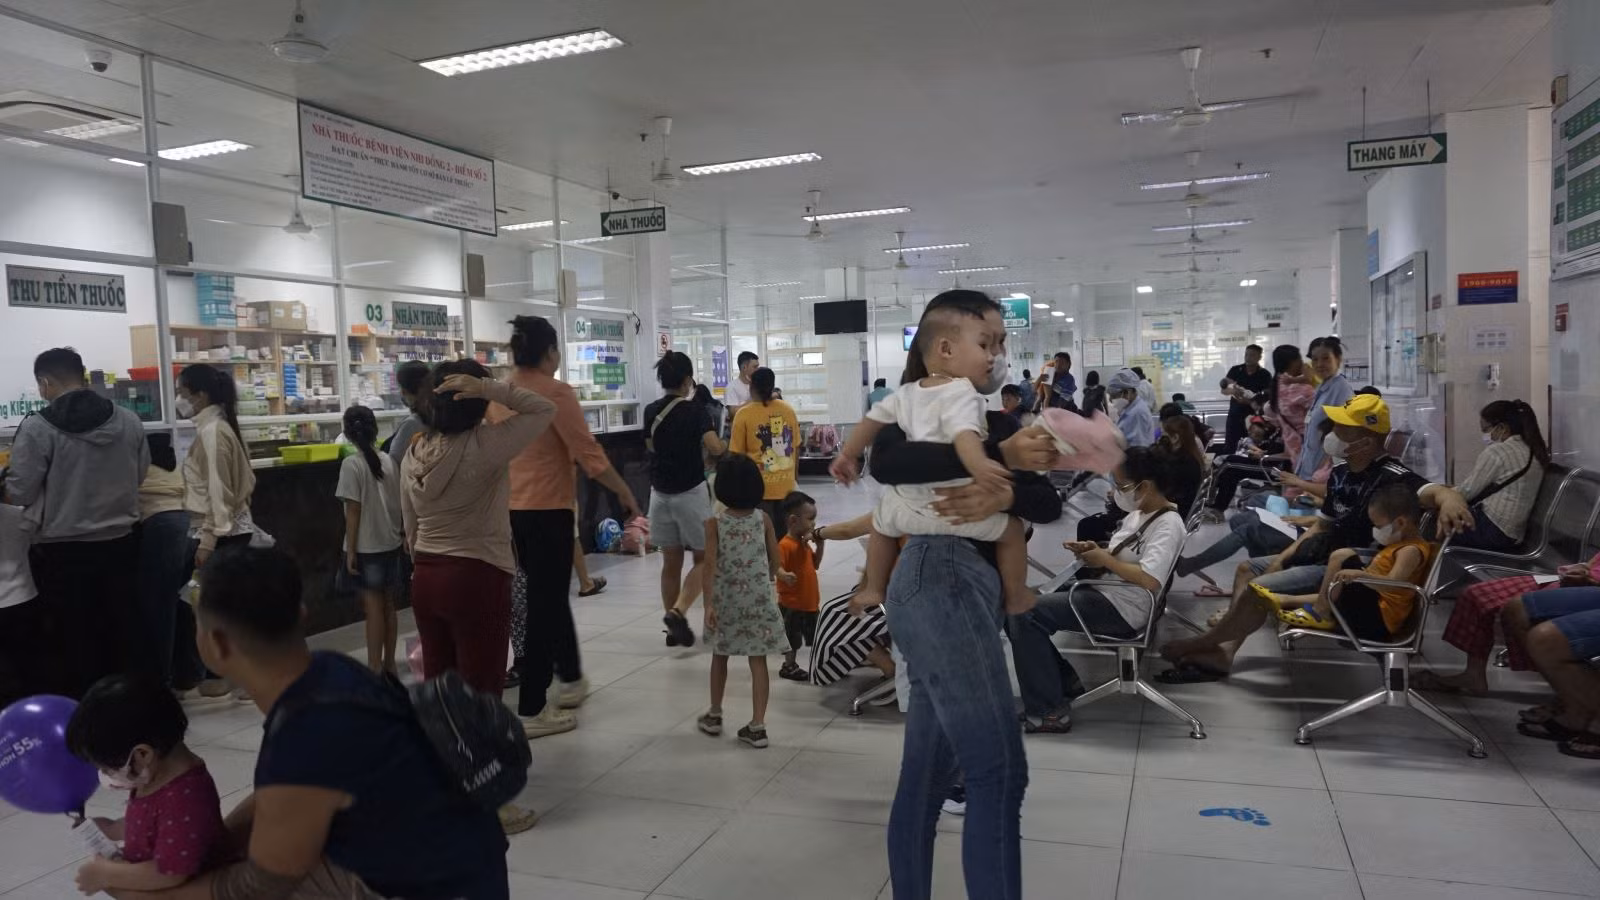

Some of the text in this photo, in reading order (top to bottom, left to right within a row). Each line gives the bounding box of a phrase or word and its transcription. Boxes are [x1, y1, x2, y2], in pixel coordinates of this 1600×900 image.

[333, 129, 364, 147] THUỐC
[365, 138, 389, 155] BỆNH
[390, 144, 409, 159] VIỆN
[411, 152, 424, 164] NHI
[1353, 139, 1427, 163] THANG MÁY
[608, 210, 663, 231] NHÀ THUỐC
[10, 273, 125, 307] THU TIỀN THUỐC
[366, 303, 447, 328] 03 NHẬN THUỐC
[576, 320, 586, 334] 04
[10, 393, 32, 416] KIỂM
